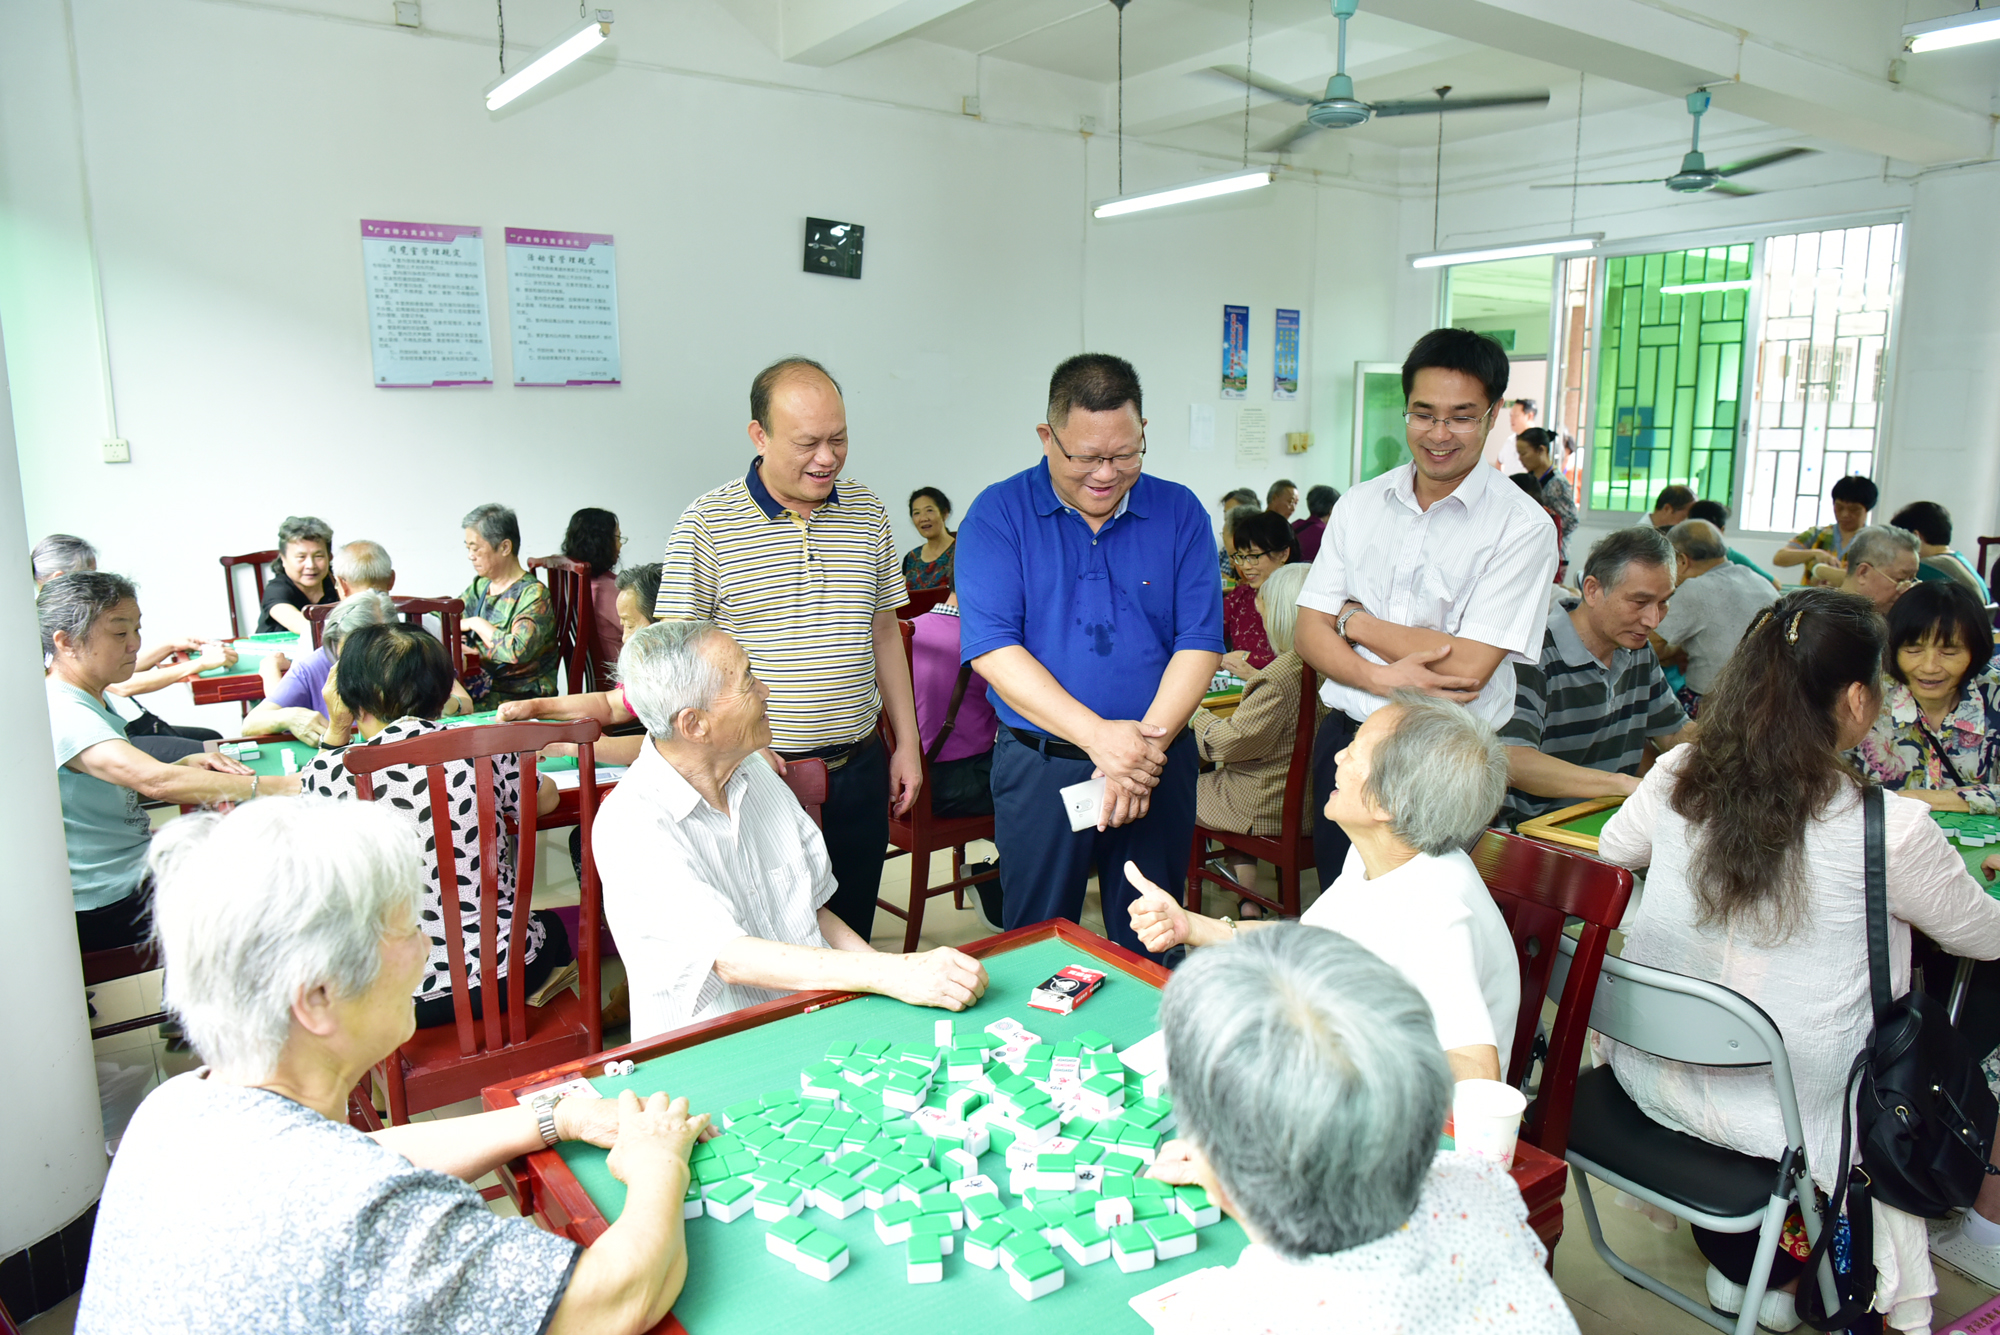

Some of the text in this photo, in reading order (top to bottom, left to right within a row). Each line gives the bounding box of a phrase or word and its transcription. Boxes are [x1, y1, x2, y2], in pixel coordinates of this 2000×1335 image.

[387, 245, 462, 258] 阅览室管理规定
[526, 253, 597, 266] 活动室管理规定
